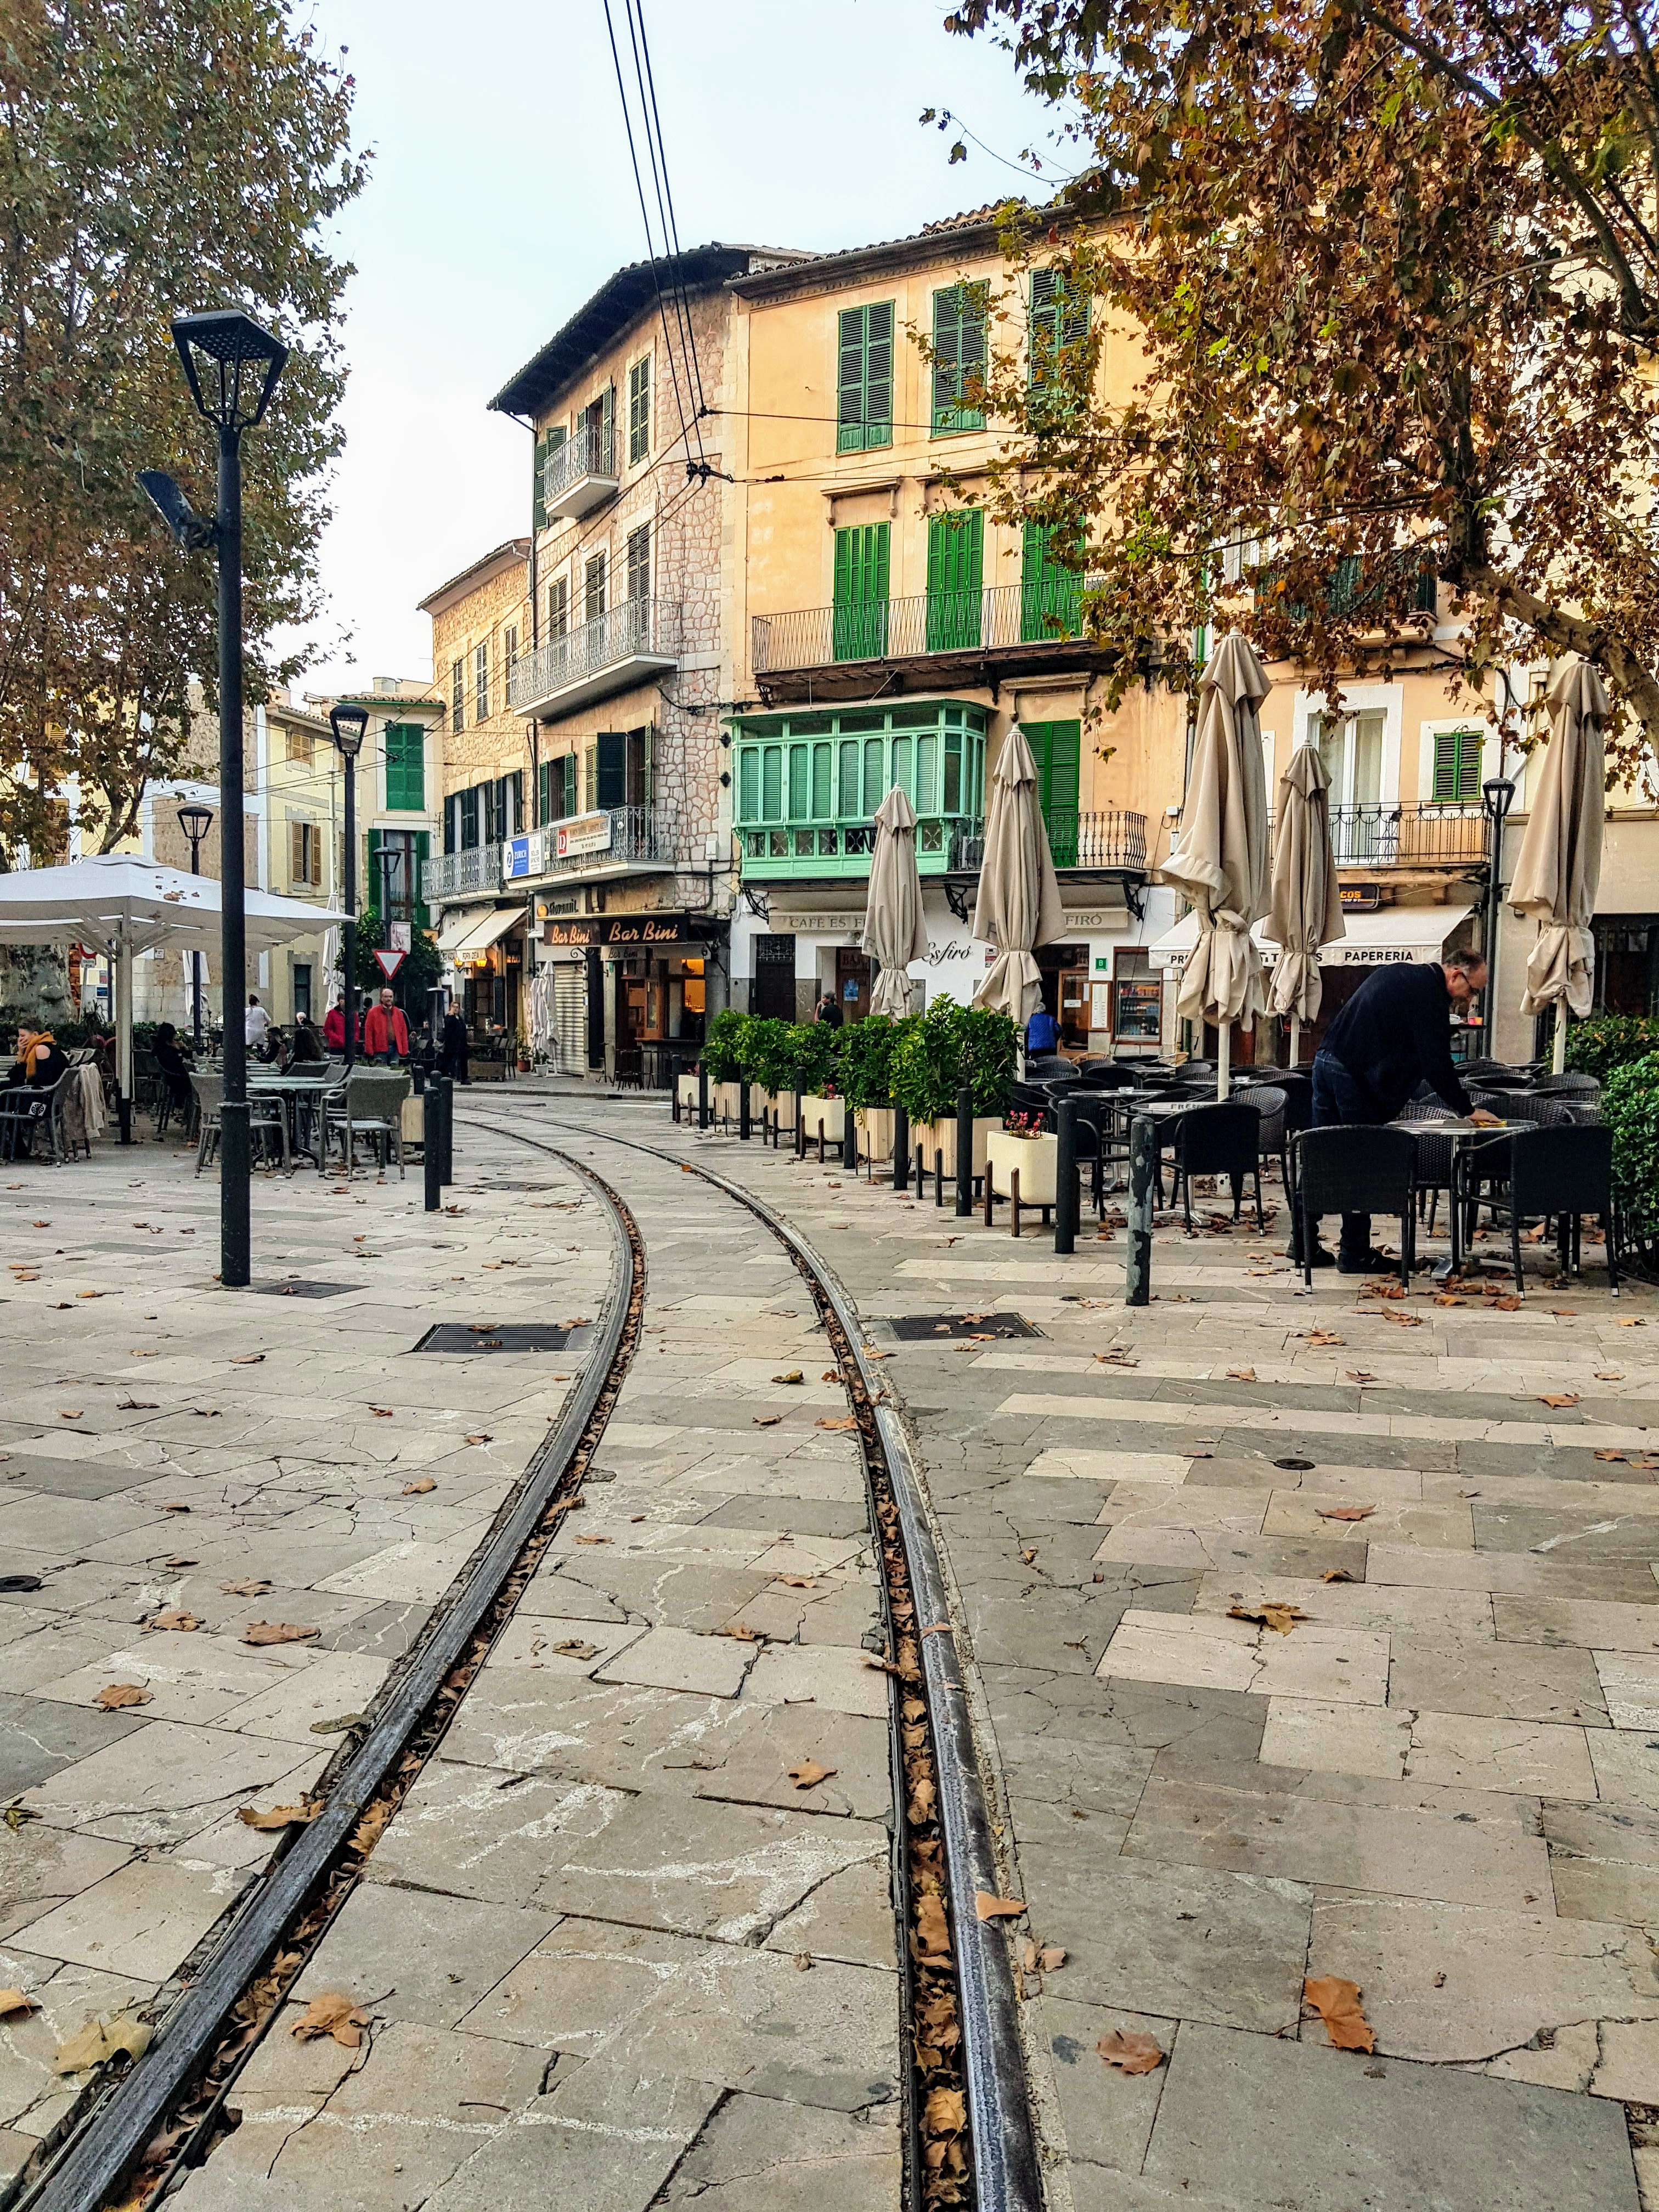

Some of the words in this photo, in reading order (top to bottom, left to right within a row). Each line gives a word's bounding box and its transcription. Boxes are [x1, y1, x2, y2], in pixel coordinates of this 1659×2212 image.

[514, 849, 527, 860] ZURICH
[830, 918, 846, 928] ES
[552, 925, 568, 944] Bar
[569, 925, 590, 944] Bini
[609, 921, 640, 941] Bar
[642, 921, 678, 940] Bini
[1345, 951, 1414, 962] PAPERERIA
